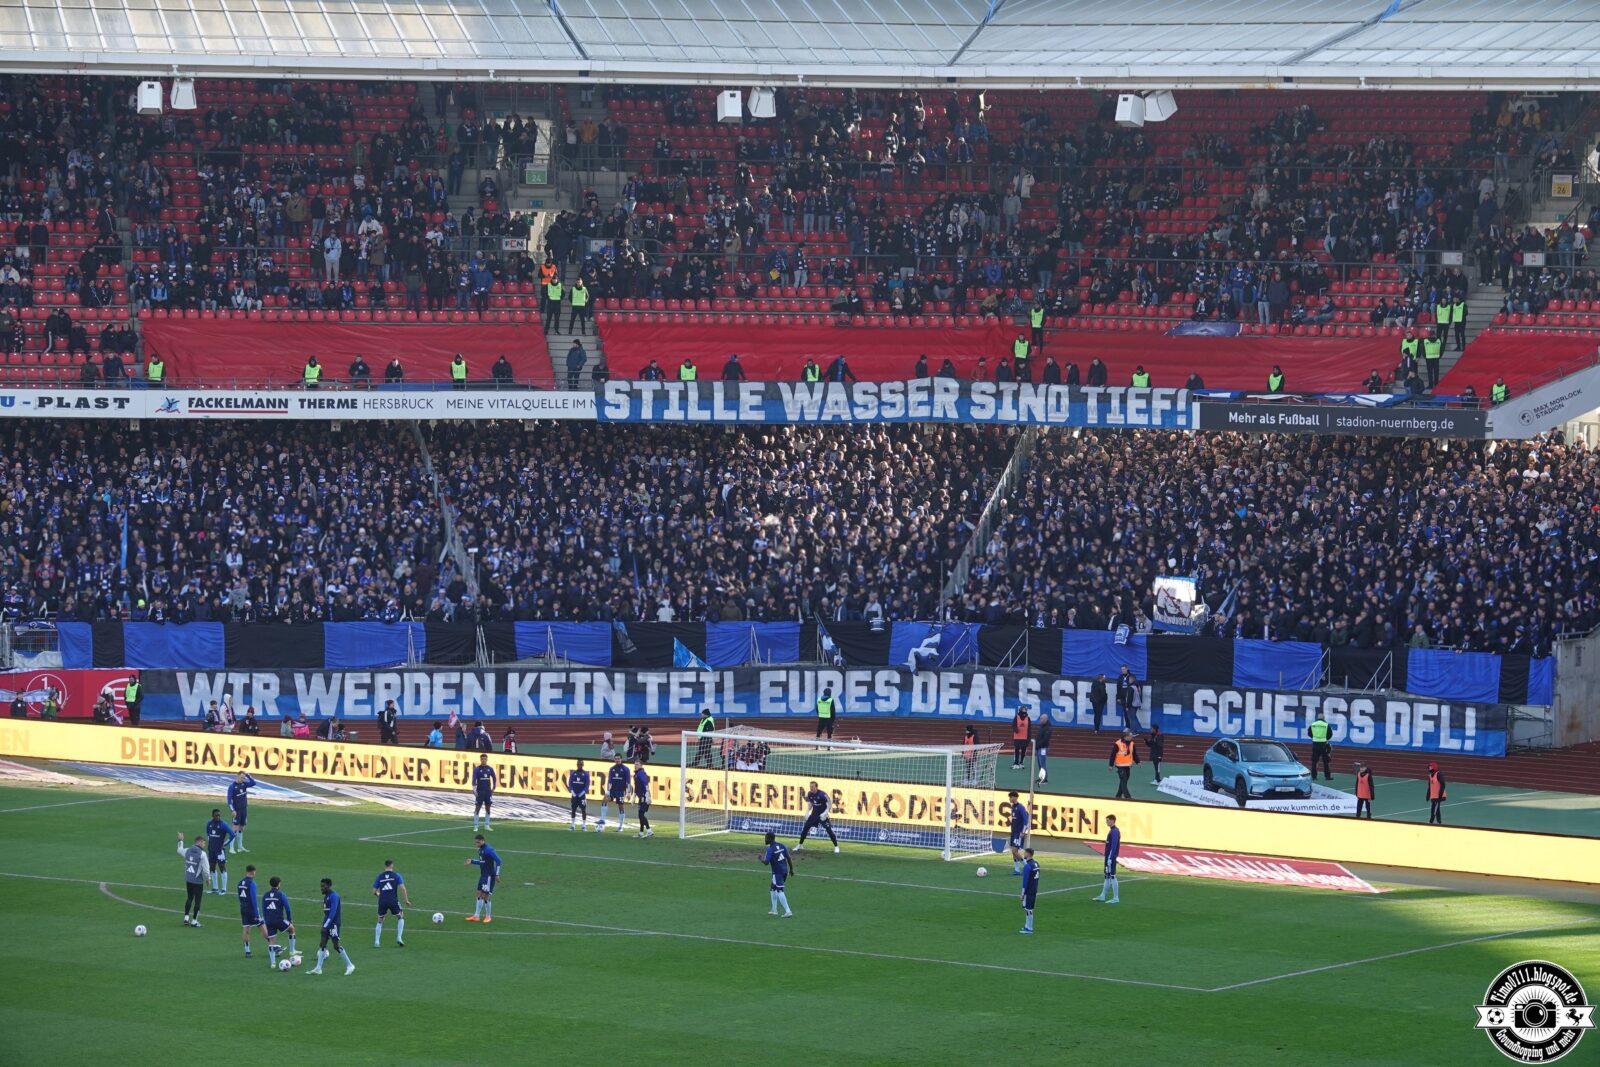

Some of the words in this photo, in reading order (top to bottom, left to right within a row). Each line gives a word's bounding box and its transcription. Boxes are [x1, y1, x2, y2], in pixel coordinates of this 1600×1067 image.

[531, 174, 541, 183] 24
[1557, 184, 1567, 194] 26
[504, 239, 524, 248] FCN
[37, 396, 131, 409] PLAST
[188, 396, 289, 409] FACKELMANN
[299, 397, 358, 409] THERME
[363, 398, 434, 409] HERSBRUCK
[446, 398, 484, 409] MEINE
[487, 398, 569, 410] VITALQUELLE
[572, 398, 586, 409] IM
[603, 379, 766, 421] STILLE
[777, 376, 960, 421] WASSER
[969, 381, 1070, 423] SIND
[1080, 385, 1190, 426] TIEF!
[1533, 402, 1550, 414] MAX
[1549, 388, 1583, 407] MORLOCK
[1535, 403, 1565, 420] STADION
[1228, 411, 1256, 424] Mehr
[1259, 412, 1276, 425] als
[1278, 413, 1320, 426] Fußball
[1336, 416, 1455, 431] stadion-nuernberg.de
[176, 671, 280, 717] WIR
[294, 671, 496, 717] WERDEN
[506, 671, 626, 716] KEIN
[637, 671, 747, 715] TEIL
[759, 670, 901, 713] EURES
[911, 669, 1041, 719] DEALS
[1193, 688, 1375, 746] SCHEISS
[1385, 701, 1477, 752] DFL!
[121, 735, 178, 764] DEIN
[184, 740, 431, 783] BAUSTOFFHÄNDLER
[439, 752, 480, 785] FÜ
[856, 790, 1099, 836] MODERNISEREN
[1268, 802, 1341, 812] www.kummich.de
